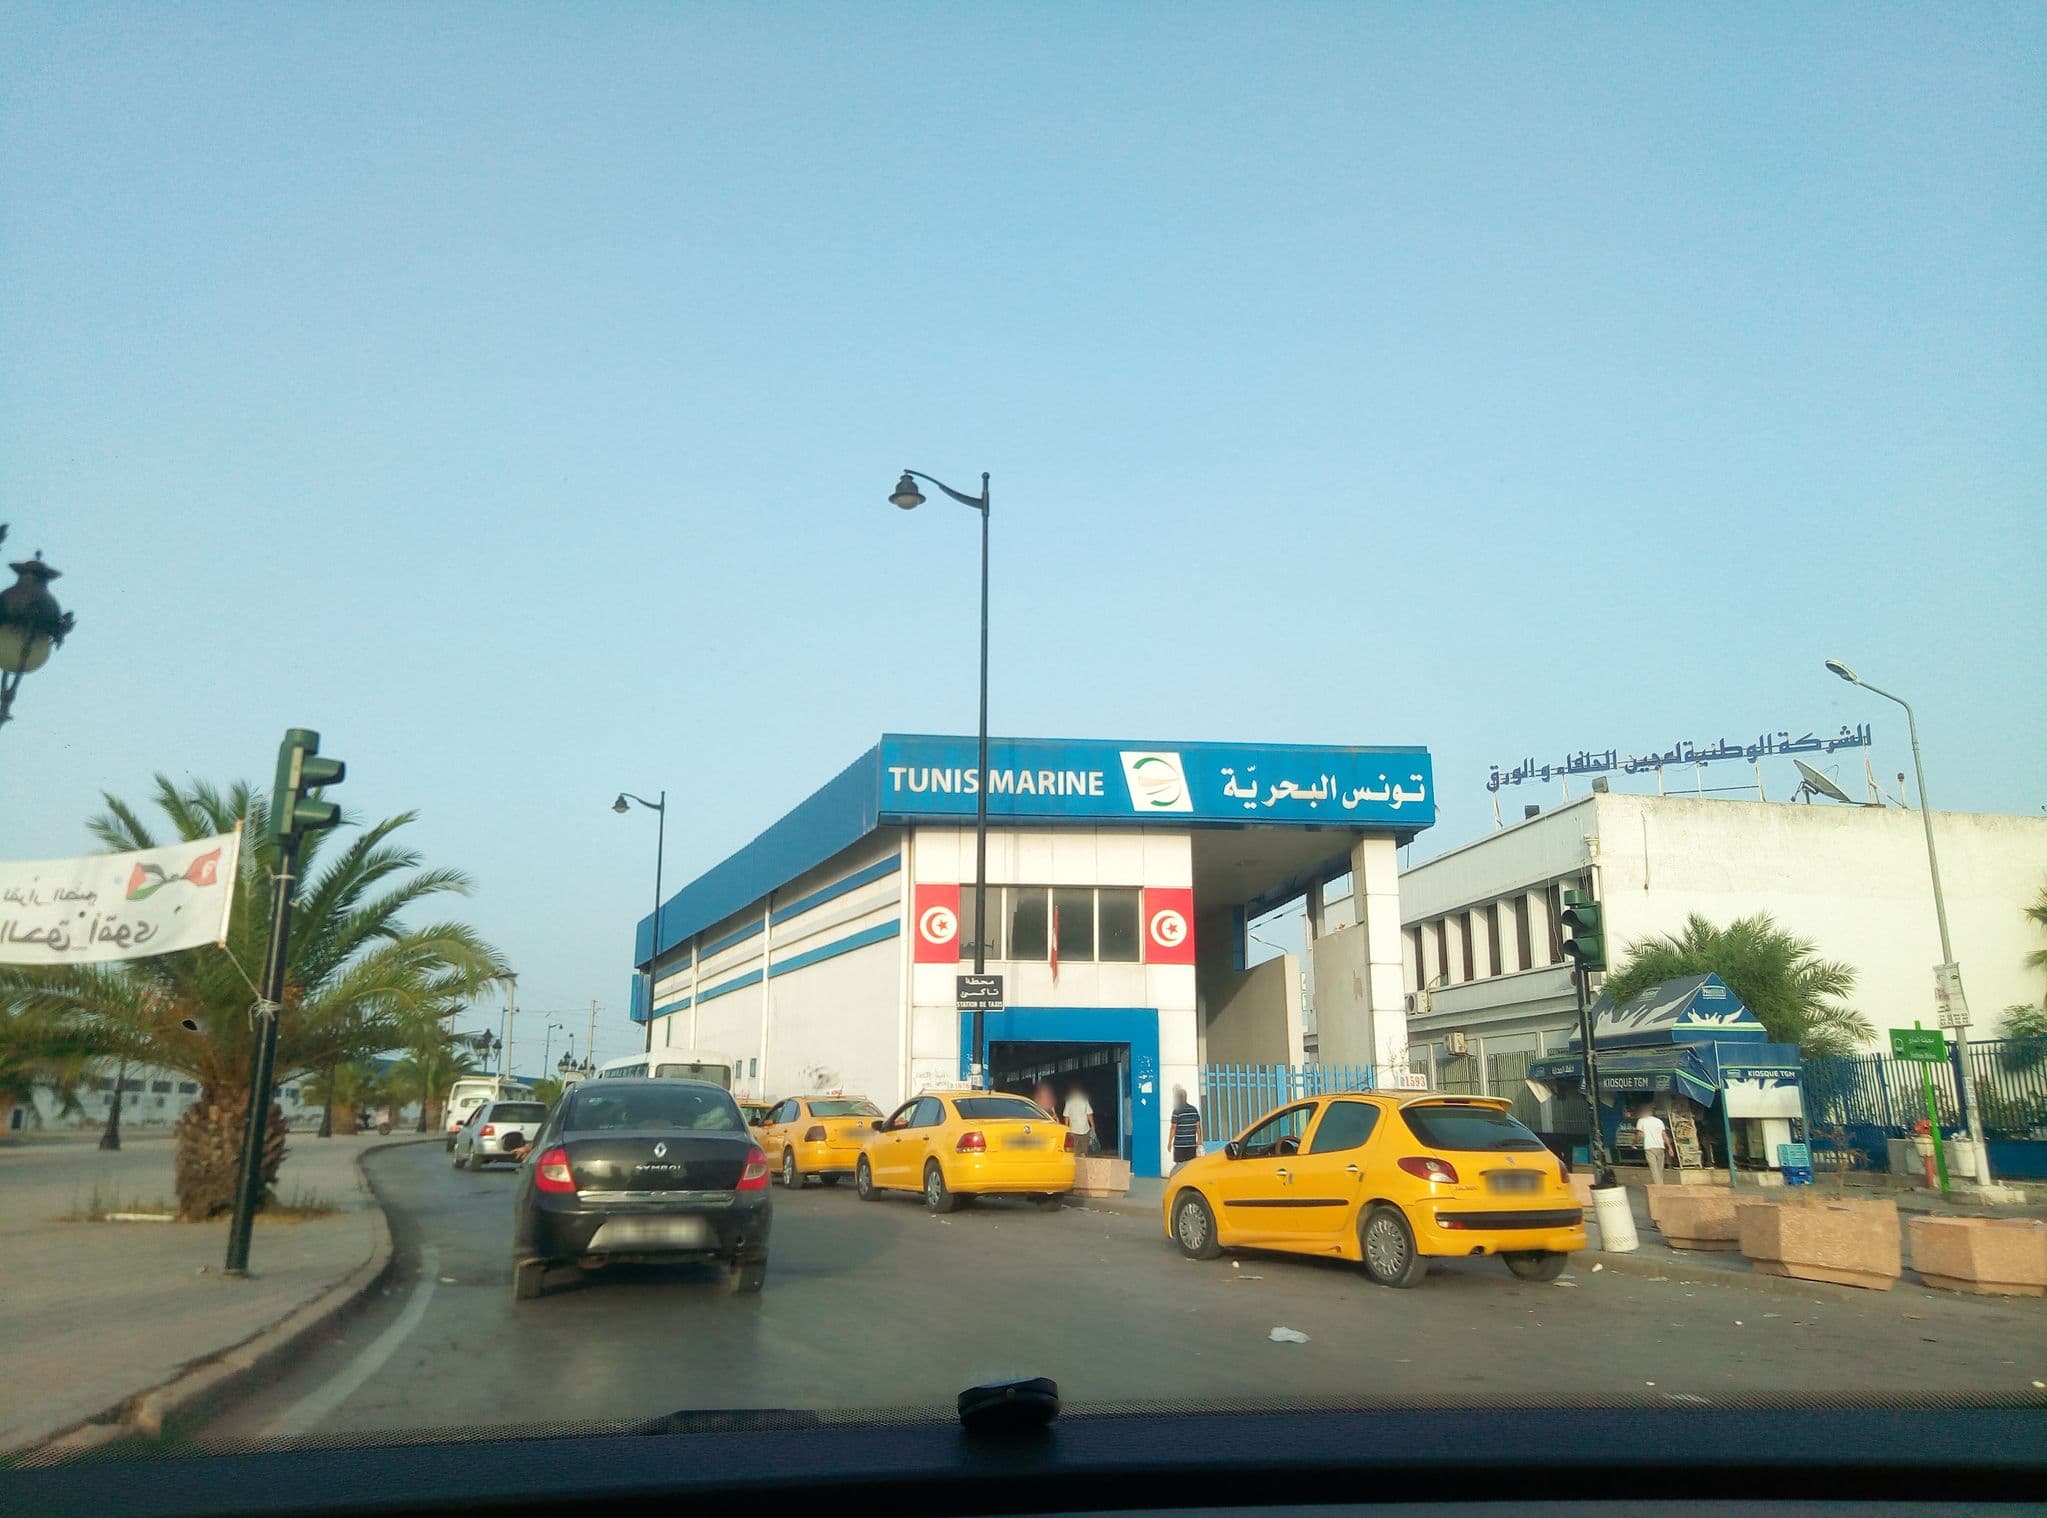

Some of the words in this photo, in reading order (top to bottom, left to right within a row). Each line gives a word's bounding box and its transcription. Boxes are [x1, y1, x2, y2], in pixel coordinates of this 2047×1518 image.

[1684, 733, 1772, 767] الوطنية
[1778, 723, 1872, 754] الشركة
[1624, 741, 1682, 774] لعجين
[888, 767, 979, 793] TUNIS
[988, 769, 1105, 796] MARINE
[1342, 773, 1425, 810] تونس
[965, 976, 995, 985] محطة
[1603, 1078, 1633, 1088] KIOSQUE
[1633, 1077, 1649, 1087] TGM
[1746, 1070, 1779, 1078] KIOSQUE
[1780, 1070, 1796, 1079] TGM
